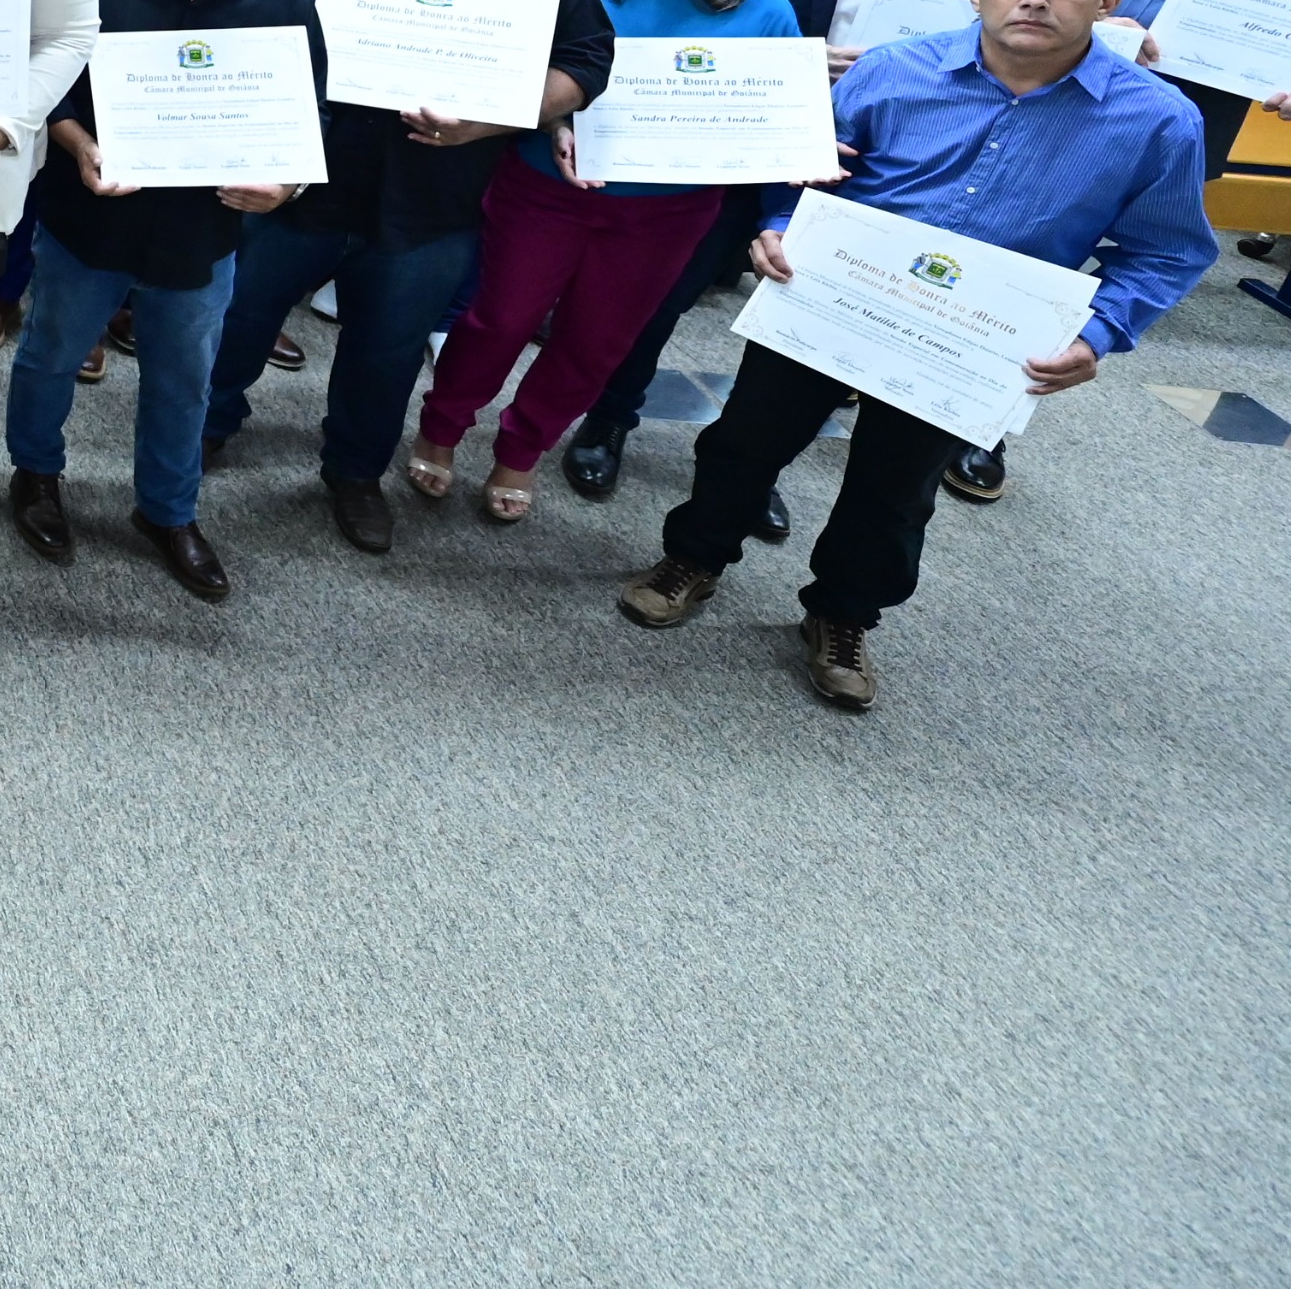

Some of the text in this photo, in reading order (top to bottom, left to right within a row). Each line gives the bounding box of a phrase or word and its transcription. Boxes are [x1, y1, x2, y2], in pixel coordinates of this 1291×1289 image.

[357, 0, 401, 14] Diploma
[404, 6, 415, 16] de
[419, 8, 454, 22] Honra
[472, 14, 512, 28] Mérito
[372, 14, 404, 25] Câmara
[405, 19, 447, 31] Municipal
[461, 25, 494, 37] Goiânia
[1240, 21, 1282, 38] Alfredo
[357, 38, 392, 49] Adriano
[395, 43, 434, 55] Andrade
[446, 50, 457, 58] de
[460, 51, 498, 63] Oliveira
[126, 73, 168, 83] Diploma
[171, 73, 182, 82] de
[186, 72, 218, 82] Honra
[237, 69, 273, 81] Mérito
[614, 76, 784, 88] Diploma de Honra ao Mérito
[144, 84, 260, 93] Câmara Municipal de Goiânia
[633, 88, 767, 97] Câmara Municipal de Goiânia
[157, 112, 249, 122] Volmar Sousa Santos
[630, 114, 769, 124] Sandra Pereira de Andrade
[832, 248, 1017, 336] Diploma de Honra ao Mérito
[847, 270, 991, 338] Câmara Municipal de Goiânia
[832, 296, 963, 360] José Matilde de Campos
